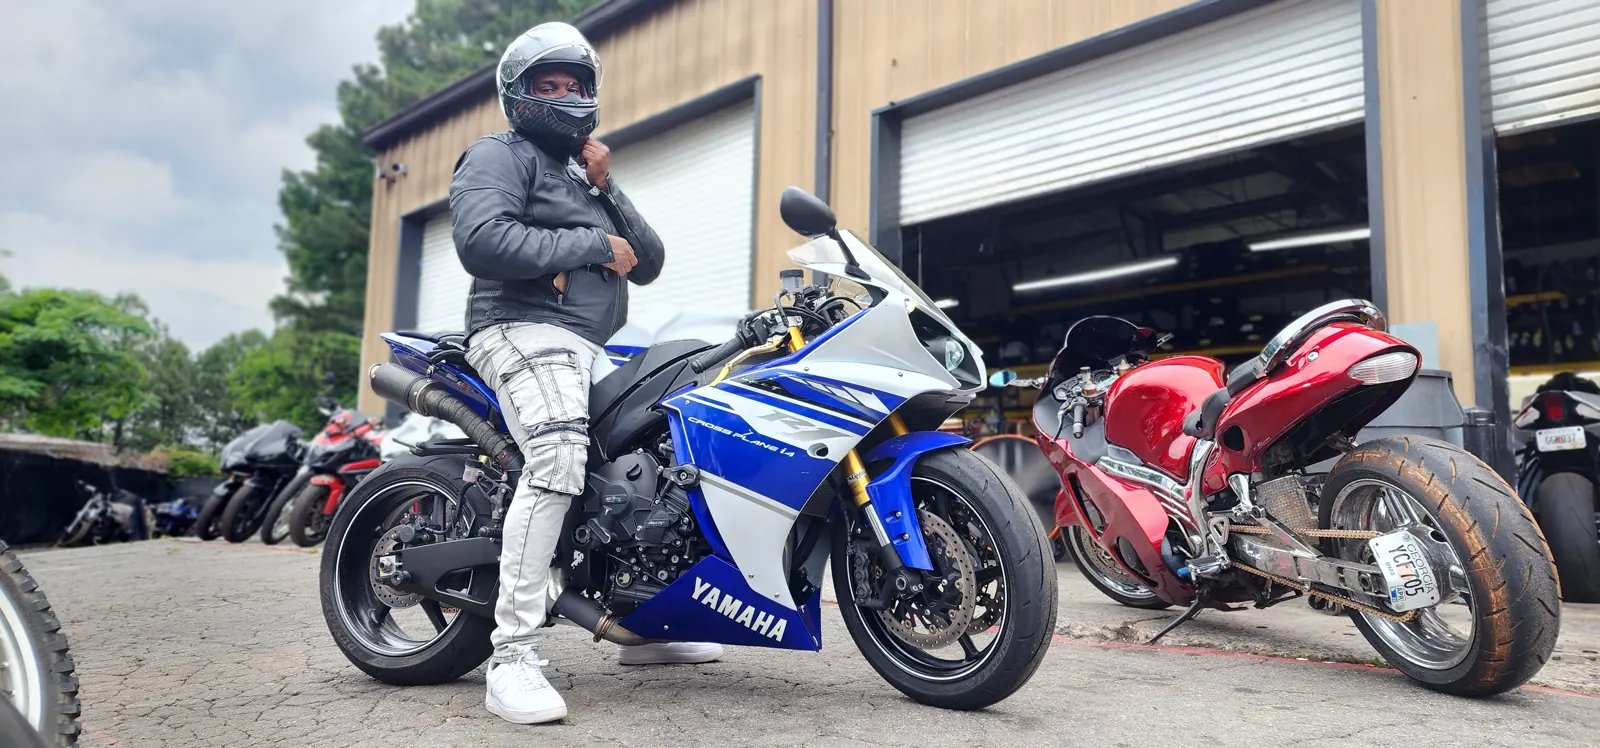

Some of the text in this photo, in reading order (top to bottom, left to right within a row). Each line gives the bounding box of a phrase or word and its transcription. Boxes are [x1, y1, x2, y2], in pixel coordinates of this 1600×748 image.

[687, 416, 733, 436] CROSS
[732, 429, 778, 452] PLANE
[1388, 545, 1424, 596] YCF705
[1407, 544, 1434, 594] GEORGIA
[691, 576, 787, 642] YAMAHA
